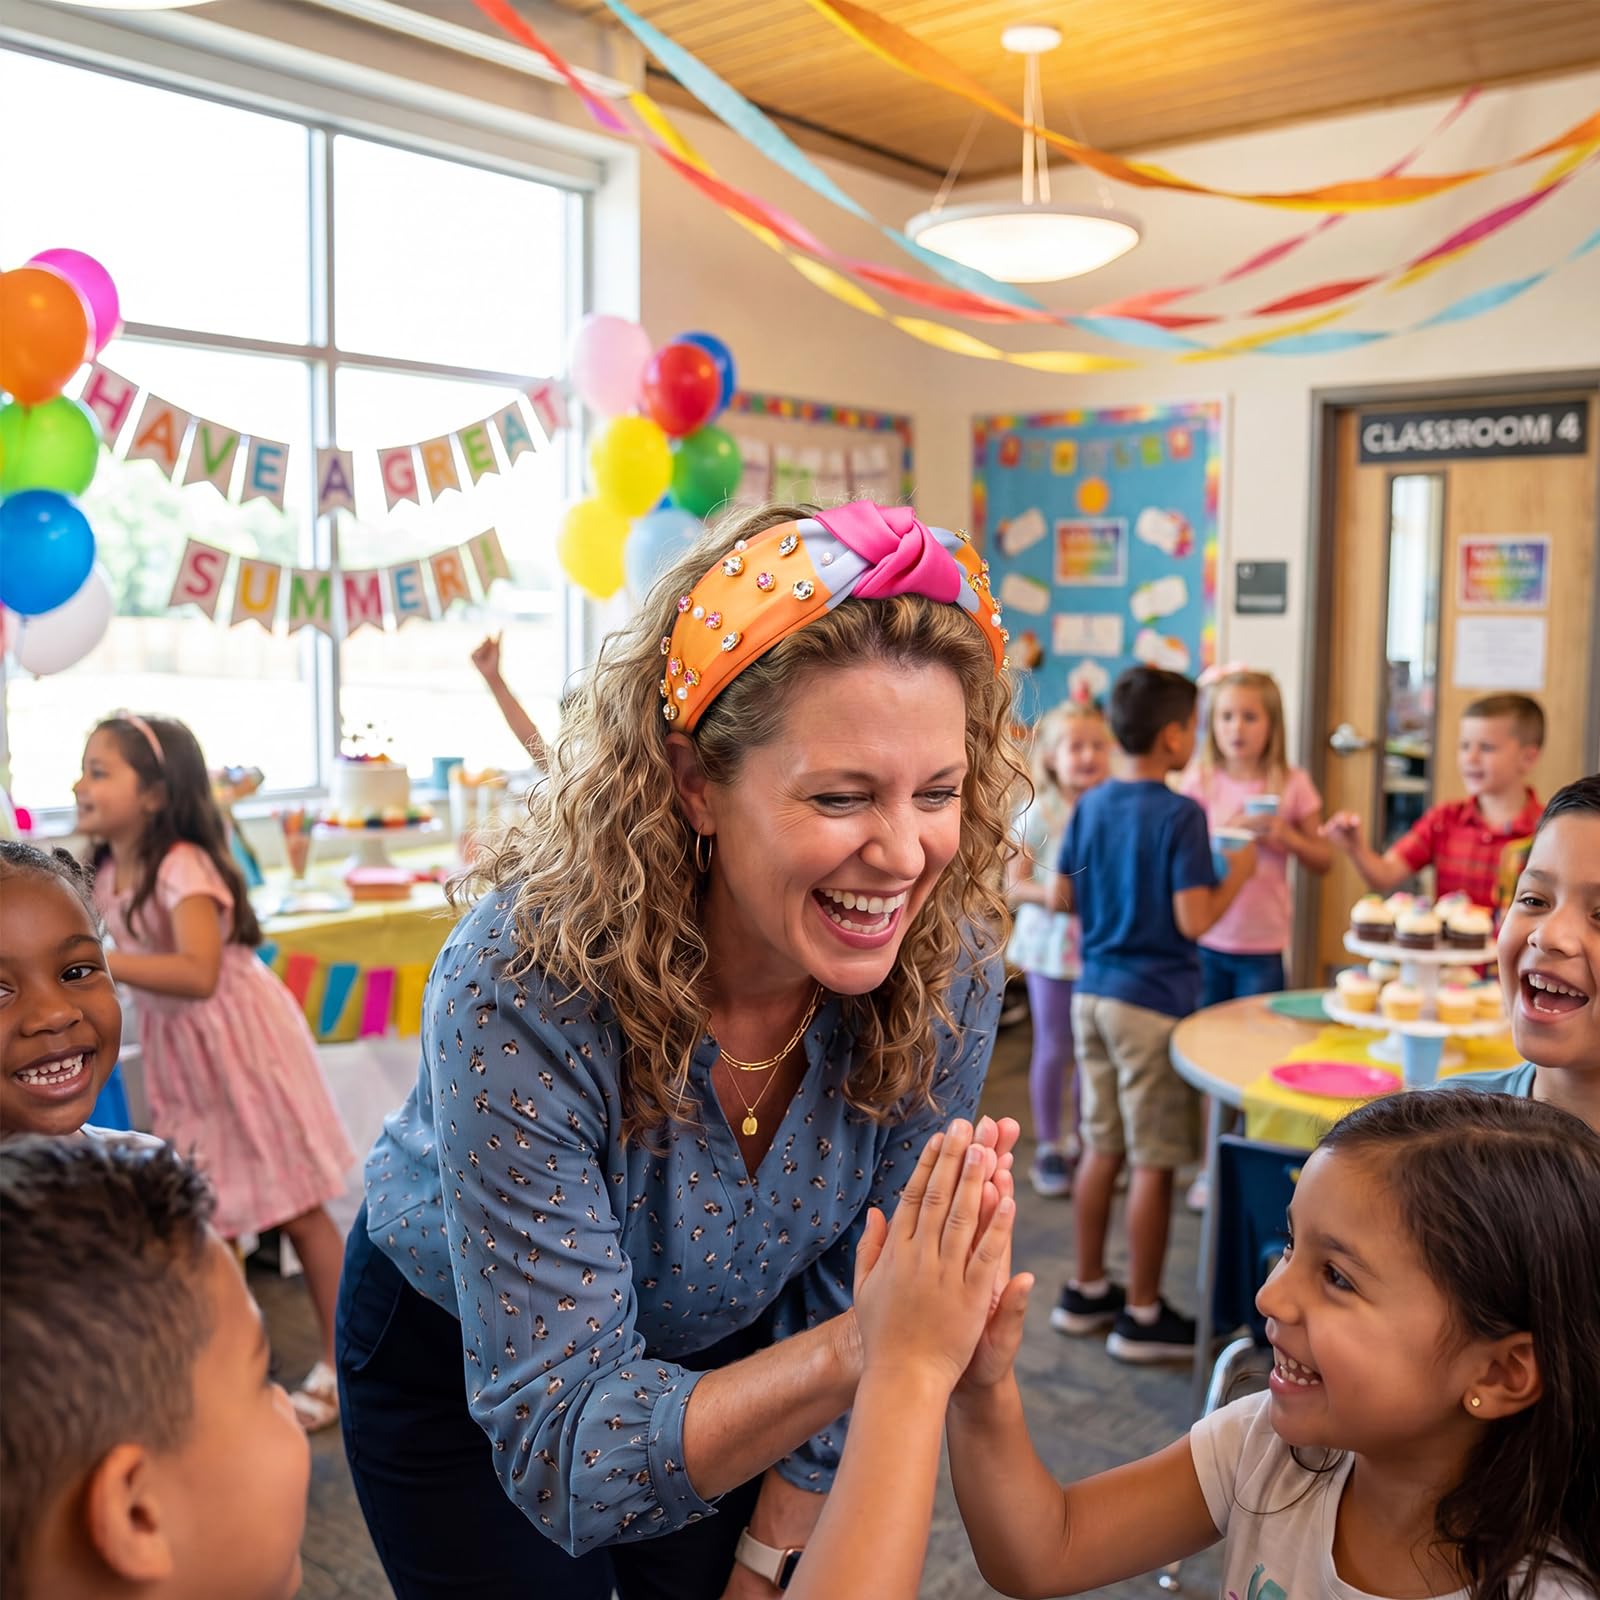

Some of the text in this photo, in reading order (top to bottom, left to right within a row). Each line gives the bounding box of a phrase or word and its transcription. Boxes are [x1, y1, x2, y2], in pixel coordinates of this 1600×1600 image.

[85, 373, 563, 499] HAVE A GREAT
[1362, 411, 1581, 453] CLASSROOM 4
[184, 545, 500, 621] SUMMER!
